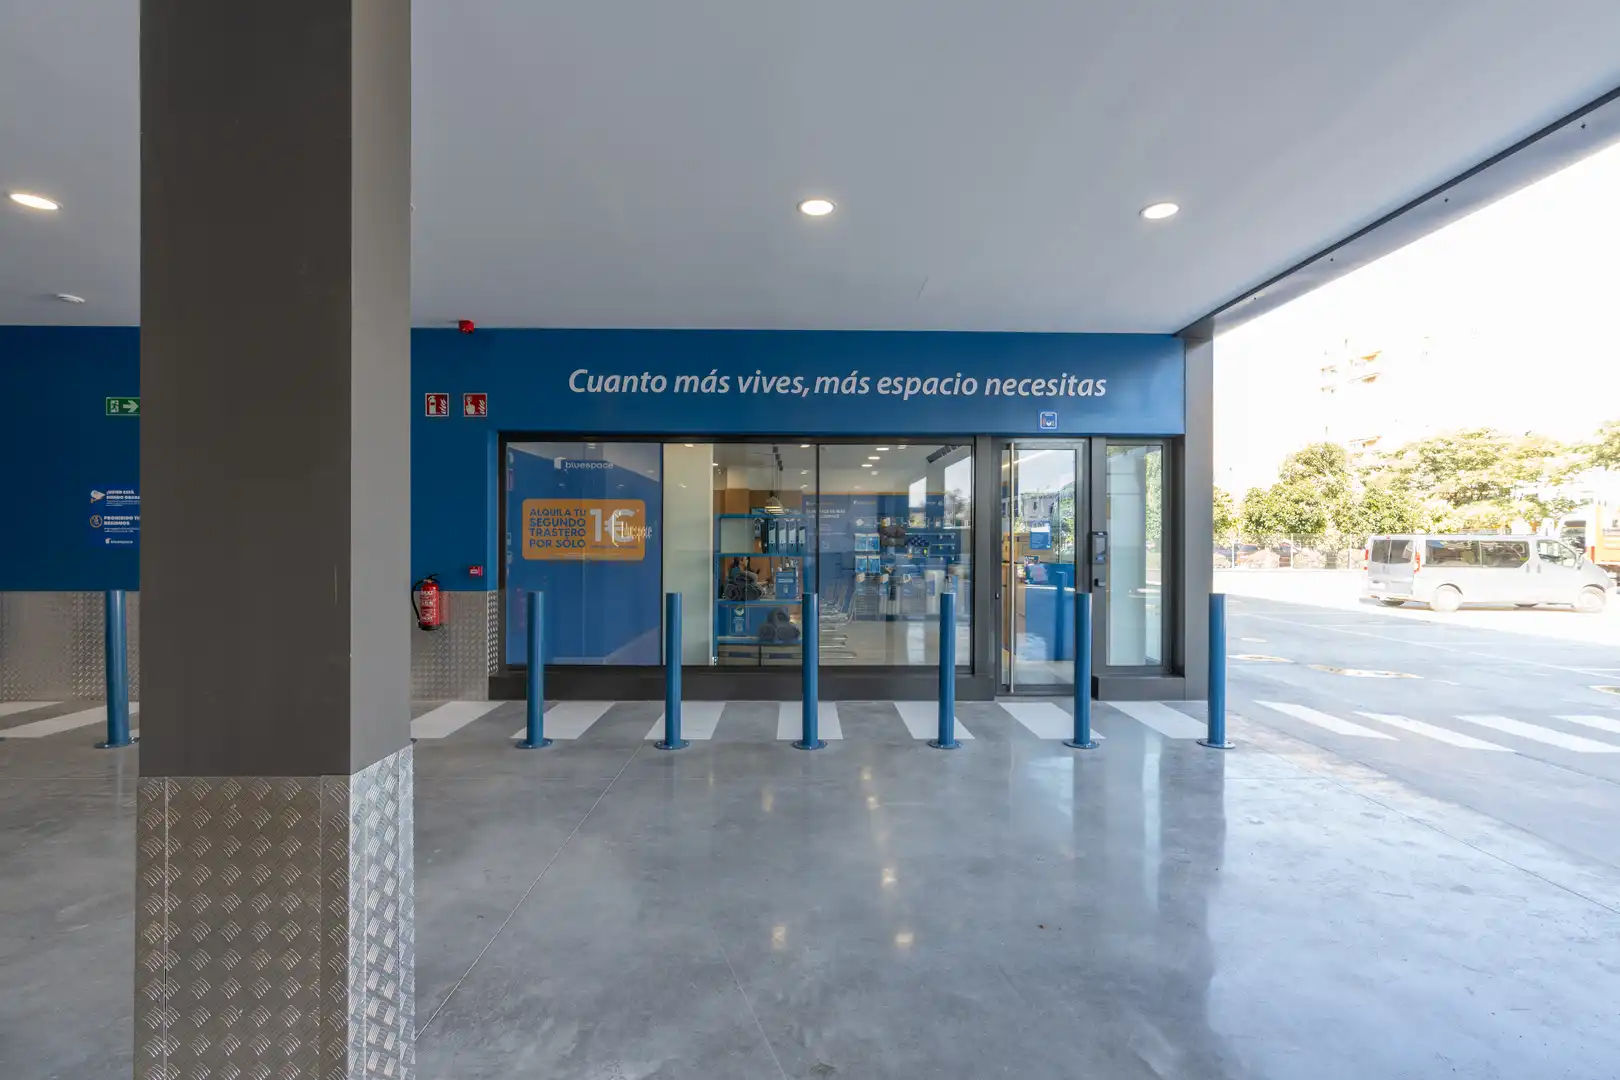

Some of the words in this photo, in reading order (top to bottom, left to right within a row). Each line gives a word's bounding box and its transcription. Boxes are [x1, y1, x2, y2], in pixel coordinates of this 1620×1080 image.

[568, 368, 667, 393] Cuanto
[673, 368, 730, 394] más
[737, 369, 810, 397] vives,
[813, 370, 871, 395] más
[876, 372, 978, 400] espacio
[984, 372, 1107, 397] necesitas
[565, 461, 614, 470] bluespace
[529, 508, 572, 517] ALQUILA
[574, 508, 587, 517] TU
[529, 518, 587, 527] SEGUNDO
[528, 528, 587, 537] TRASTERO
[529, 539, 552, 548] POR
